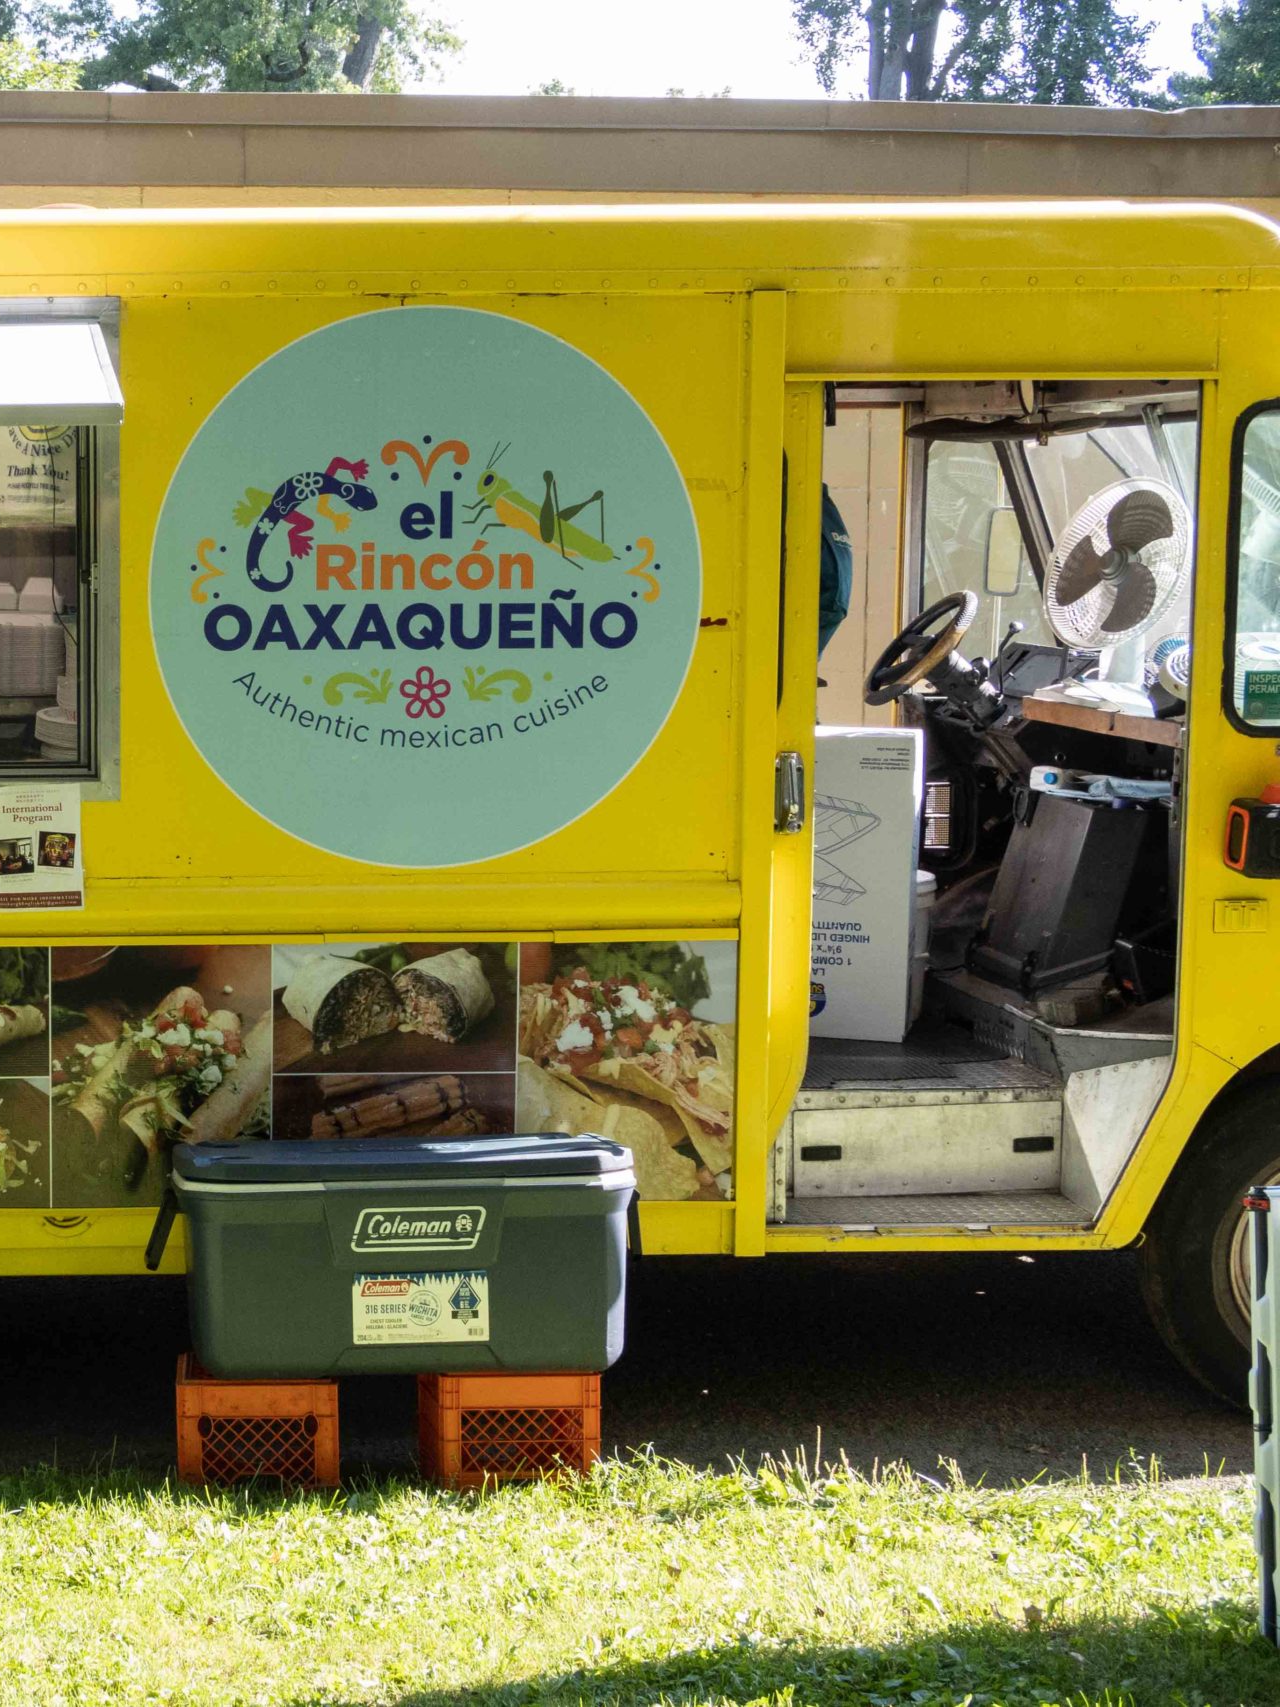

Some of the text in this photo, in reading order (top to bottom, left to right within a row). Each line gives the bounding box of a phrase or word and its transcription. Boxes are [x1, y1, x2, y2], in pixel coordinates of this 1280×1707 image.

[30, 444, 64, 456] Nice
[7, 464, 69, 480] Thank You!
[400, 491, 454, 540] el
[316, 540, 534, 592] Rincón
[204, 589, 638, 652] OAXAQUEÑO
[232, 670, 609, 750] Authentic mexican cuisine
[2, 802, 62, 814] International
[12, 814, 52, 824] Program
[830, 934, 870, 944] HINGED
[812, 956, 852, 966] 1 COMP
[367, 1214, 452, 1238] Coleman
[364, 1282, 401, 1294] Coleman
[365, 1304, 407, 1314] 316 SERIES
[408, 1302, 438, 1318] WICHITA
